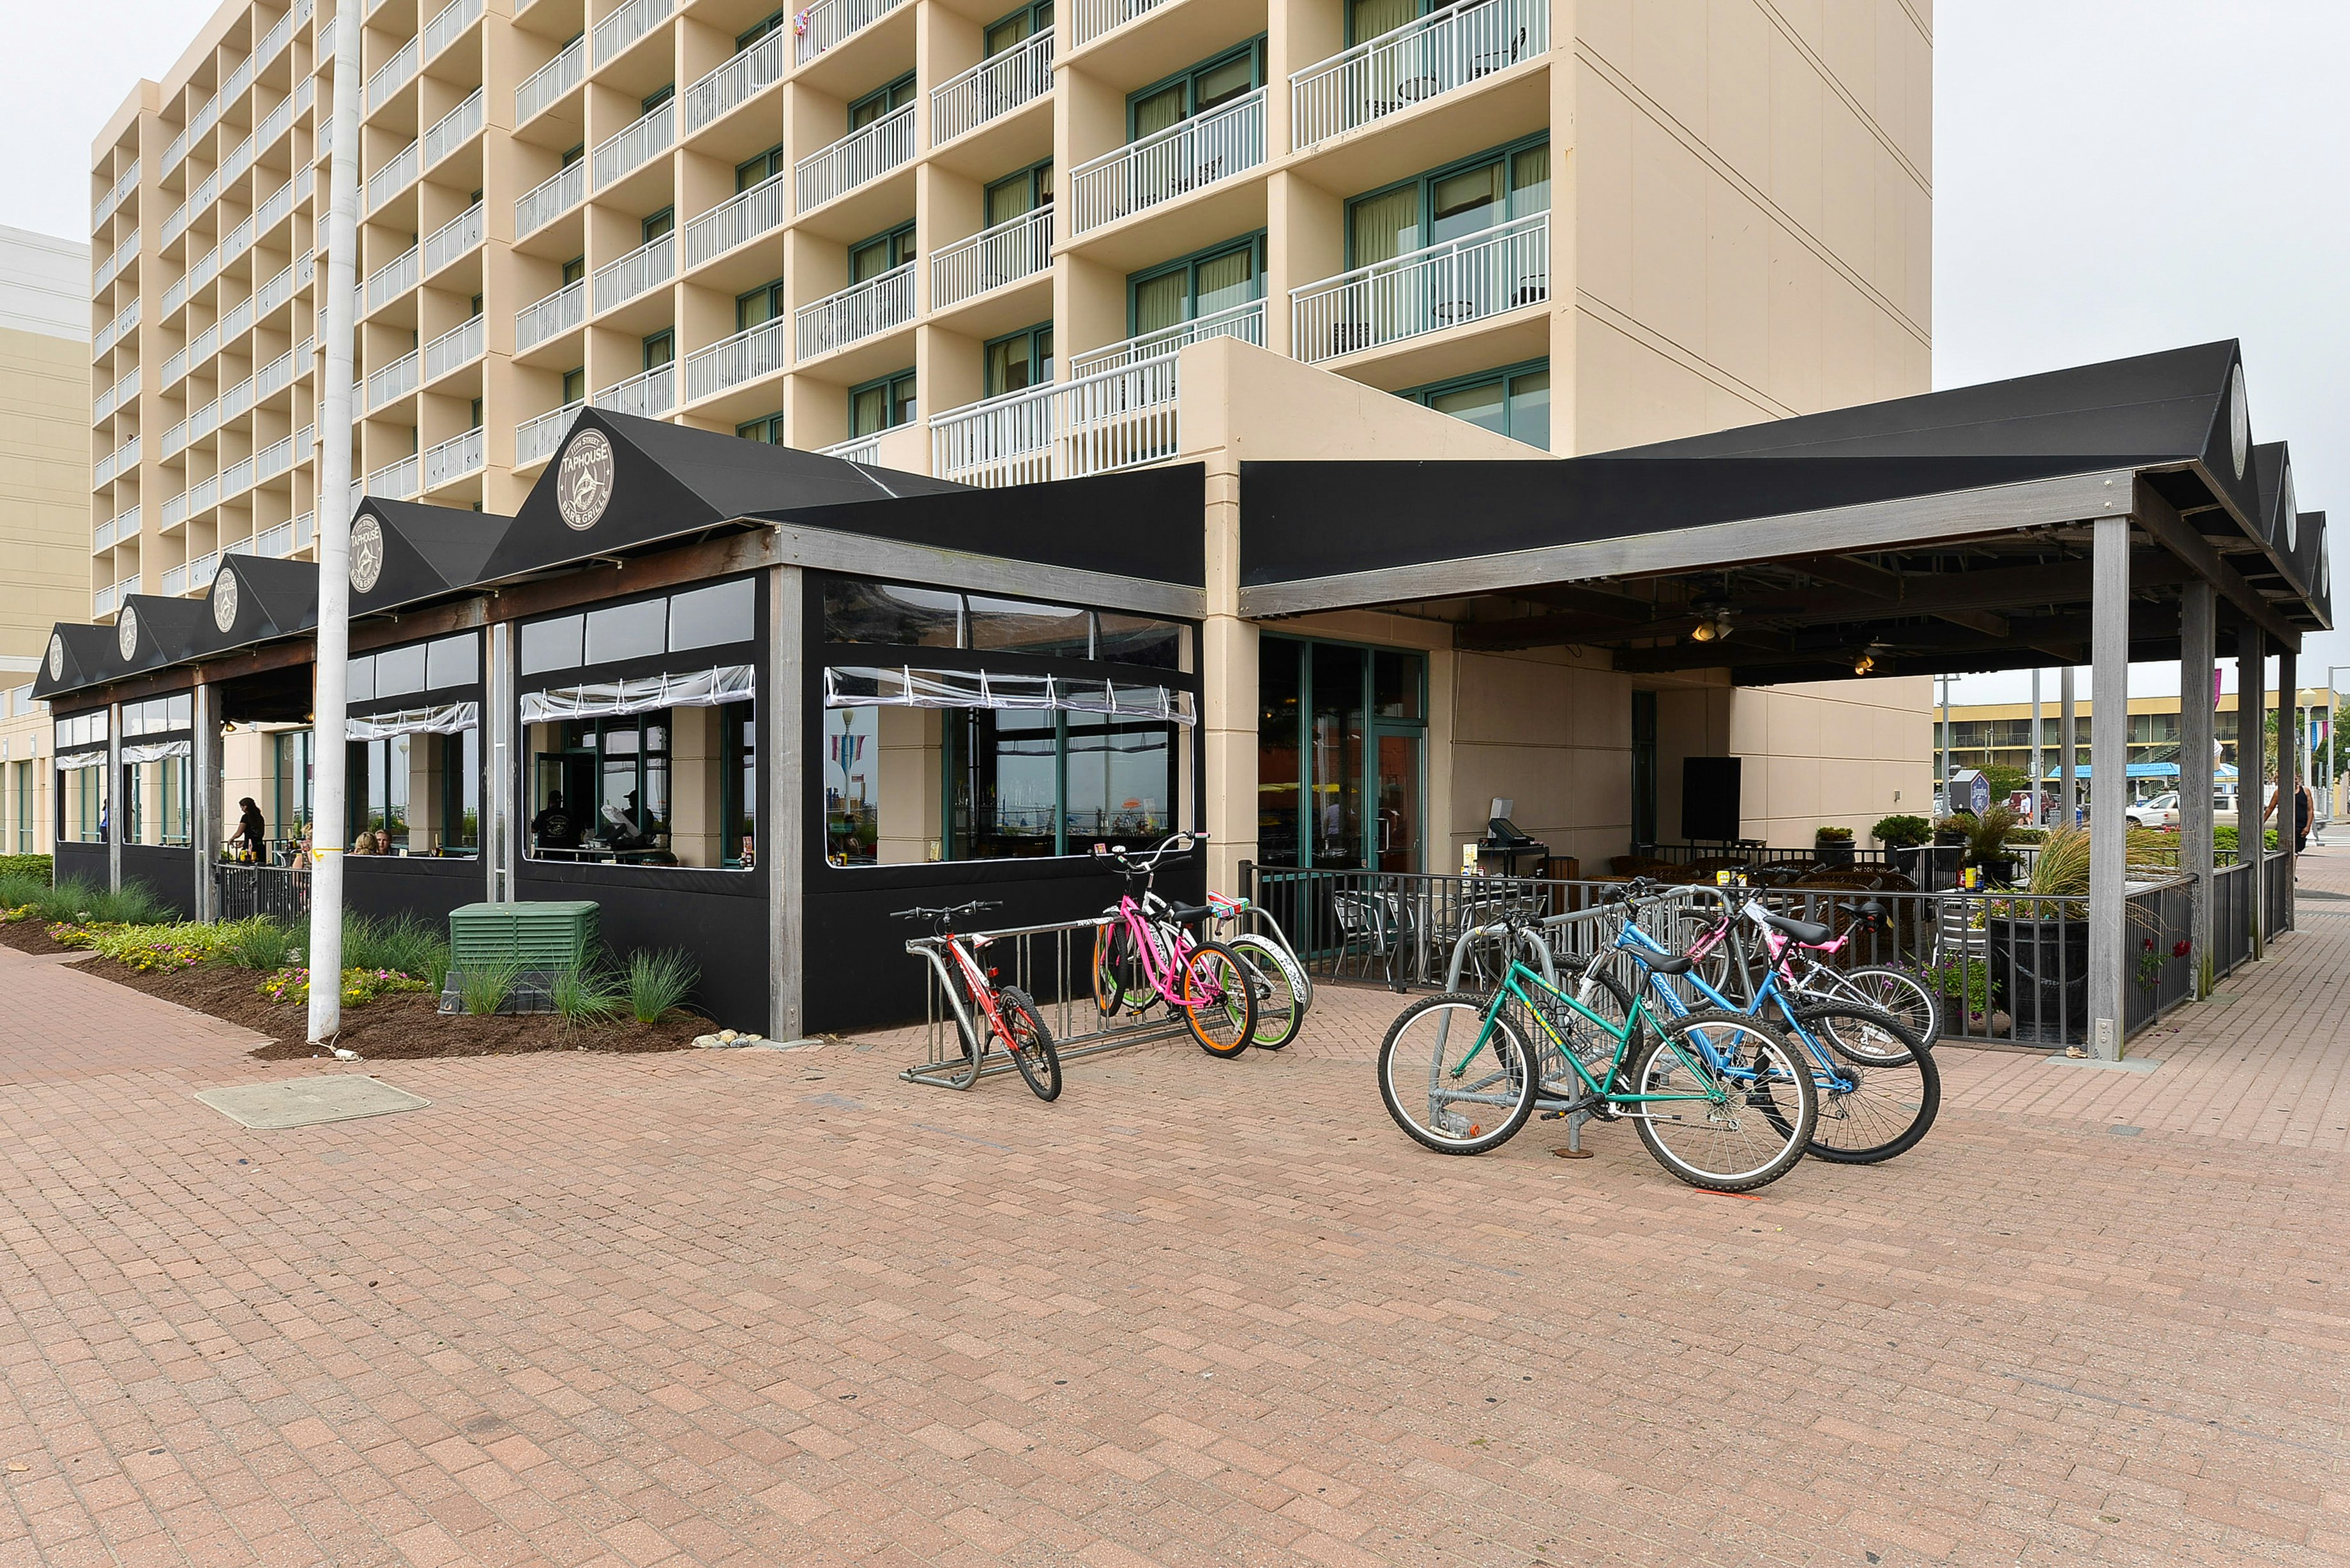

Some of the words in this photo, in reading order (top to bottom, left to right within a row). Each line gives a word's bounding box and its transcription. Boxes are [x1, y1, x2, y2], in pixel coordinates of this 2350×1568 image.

[563, 443, 608, 473] TAPHOUSE
[571, 441, 582, 455] 11TH
[582, 437, 600, 447] STREET
[562, 500, 575, 522] BAR
[582, 490, 608, 523] GRILLE
[351, 526, 379, 547] TAPHOUSE
[1524, 1000, 1562, 1045] RALEIGH
